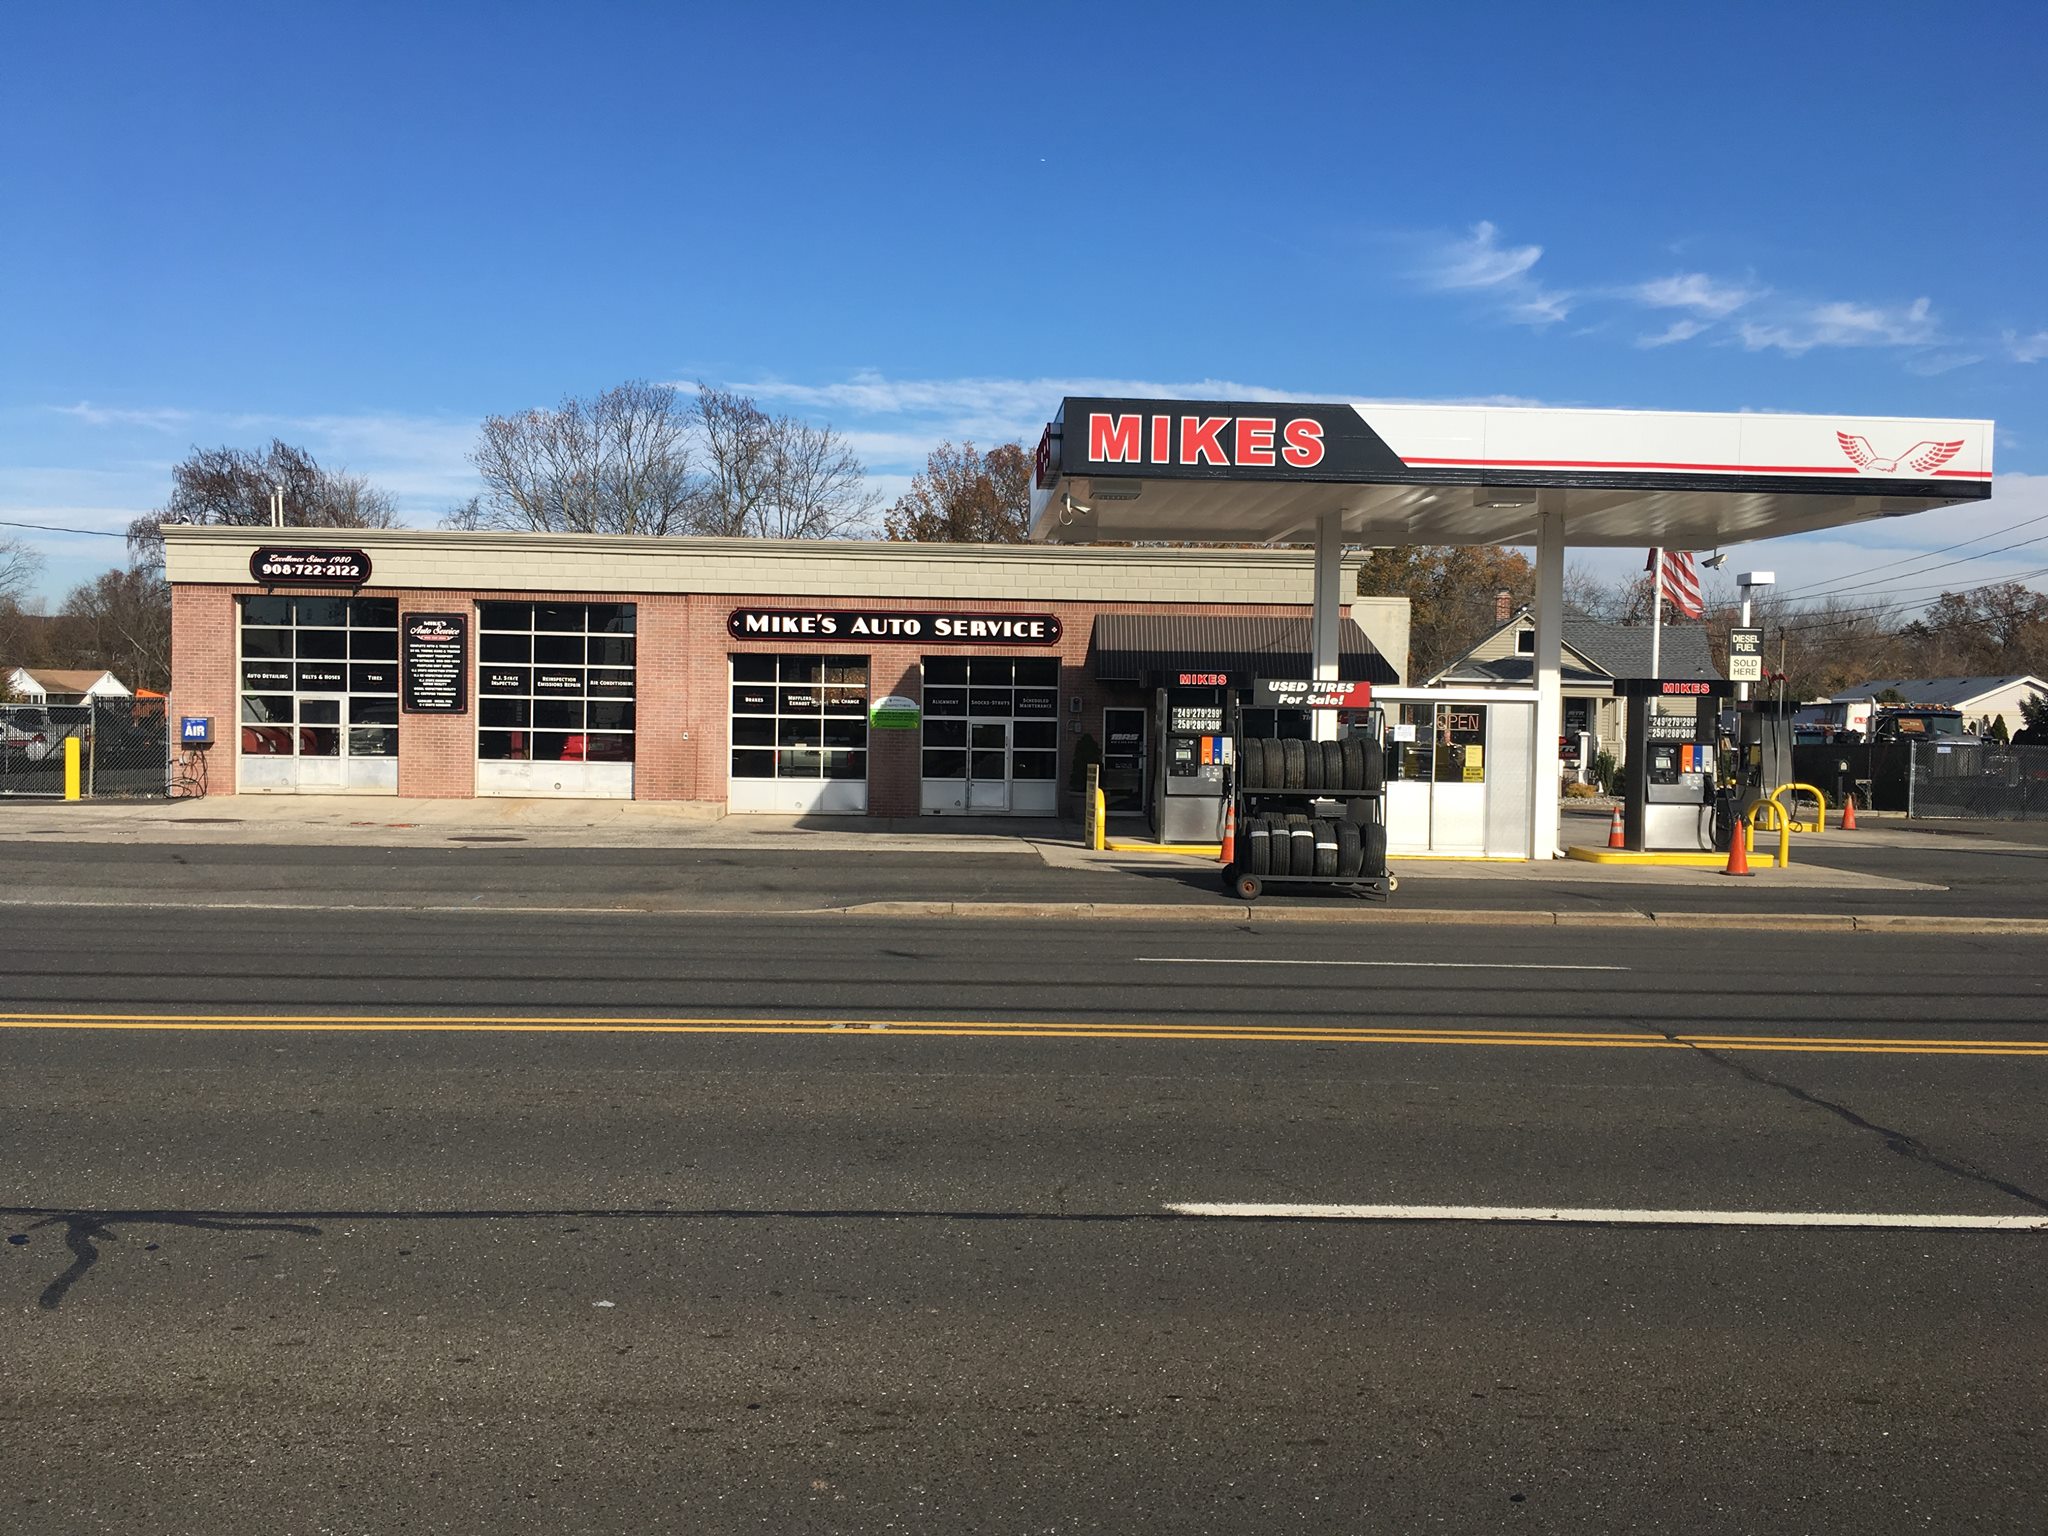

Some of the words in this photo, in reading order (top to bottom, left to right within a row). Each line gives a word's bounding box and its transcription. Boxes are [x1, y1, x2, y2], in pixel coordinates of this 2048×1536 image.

[1088, 413, 1326, 469] MIKES
[269, 554, 304, 563] Excellence
[306, 554, 327, 563] Since
[409, 626, 431, 635] Auto
[432, 626, 460, 635] Service
[745, 613, 837, 634] MIKE'S
[850, 616, 921, 635] AUTO
[934, 618, 1045, 638] SERVICE
[1732, 634, 1760, 643] DIESEL
[1736, 643, 1756, 652] FUEL
[1733, 659, 1757, 667] SOLD
[1733, 668, 1757, 676] HERE
[1179, 674, 1227, 685] MIKES
[1268, 681, 1309, 692] USED
[1312, 682, 1355, 693] TIRES
[1662, 683, 1710, 694] MIKES
[1278, 693, 1303, 704] For
[1306, 694, 1345, 705] Sale!
[1437, 714, 1479, 730] OPEN
[184, 725, 205, 737] AIR
